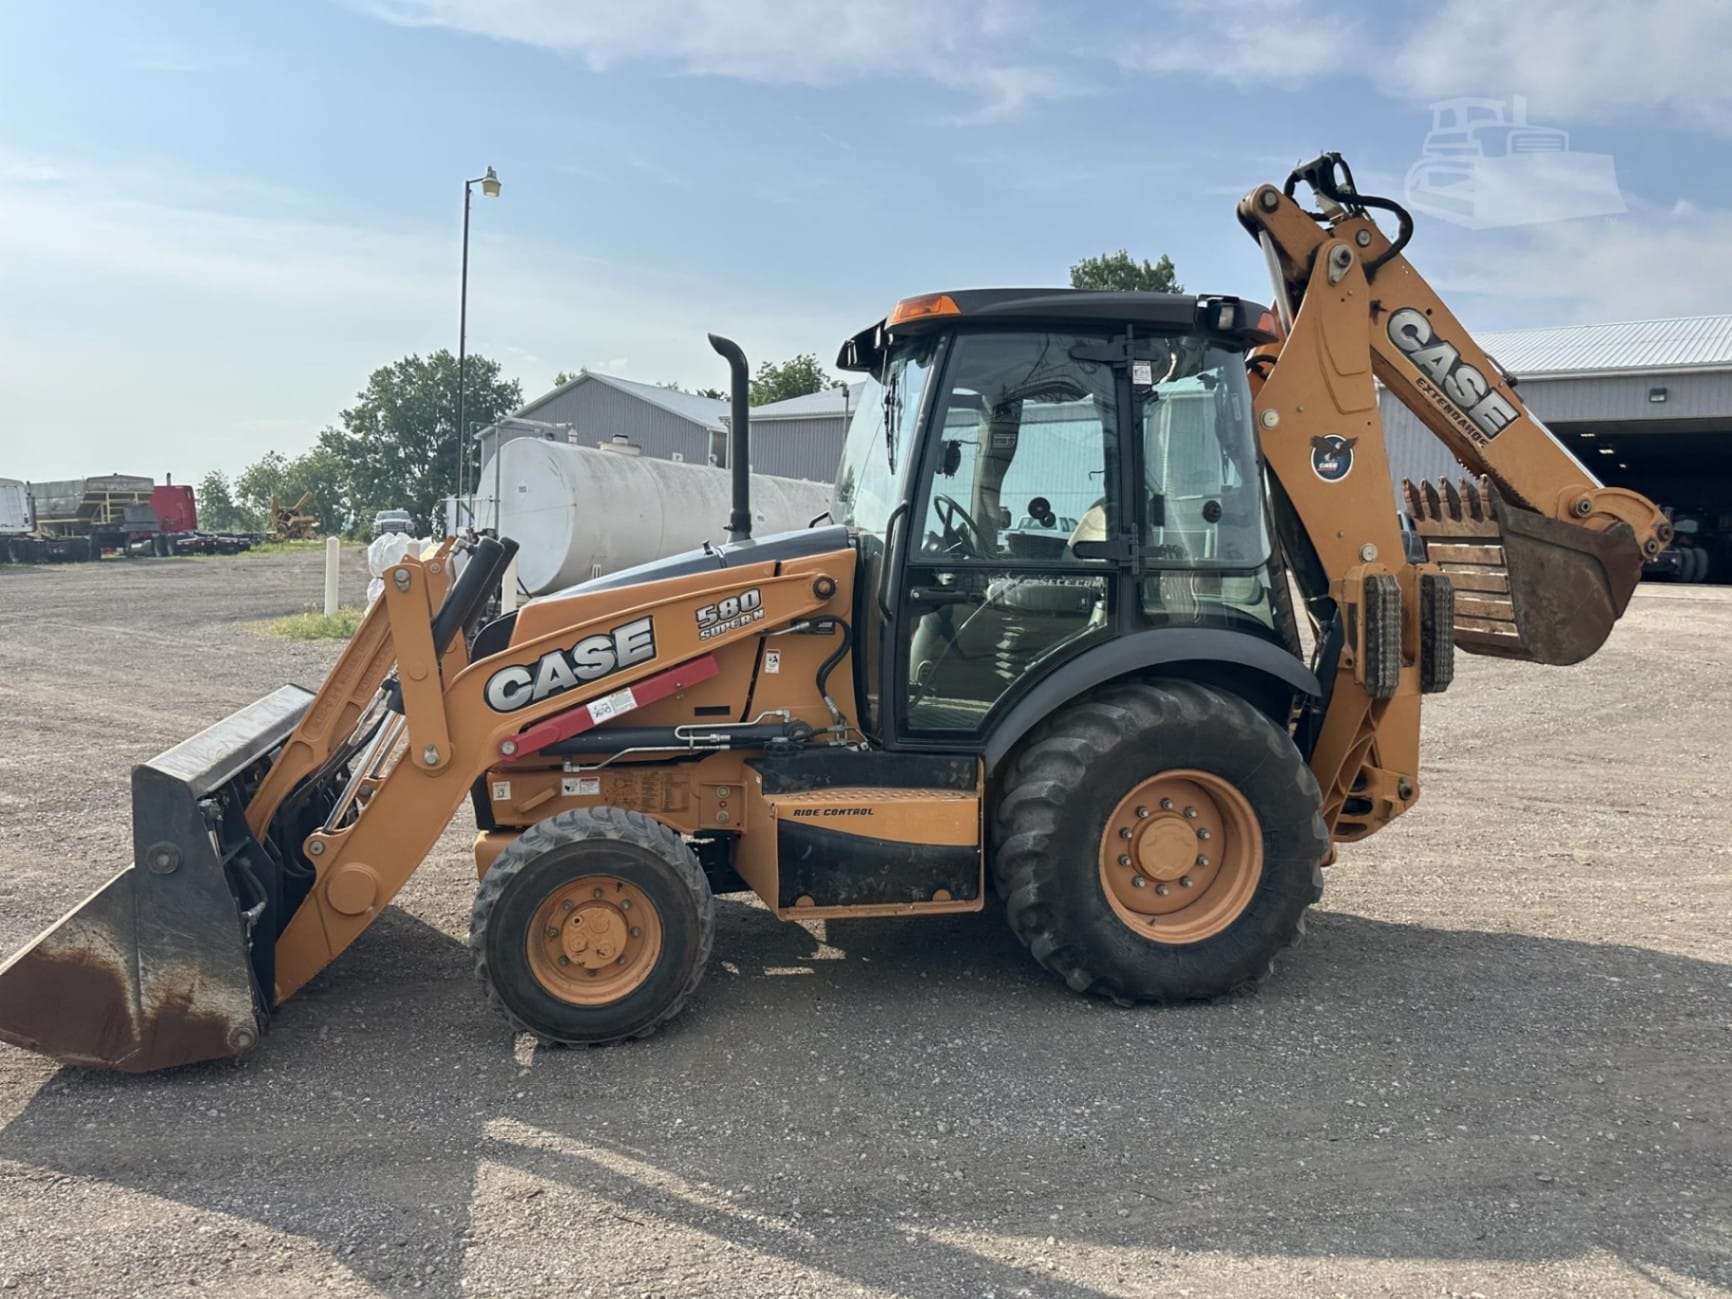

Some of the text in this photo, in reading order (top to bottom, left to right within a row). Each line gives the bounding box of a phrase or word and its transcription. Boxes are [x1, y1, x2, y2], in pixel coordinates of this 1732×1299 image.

[1388, 309, 1521, 438] CASE
[1416, 377, 1489, 448] EXTENDAHOE
[695, 588, 762, 629] 580
[699, 614, 752, 640] SUPER
[486, 616, 656, 713] CASE
[793, 807, 874, 817] RIDE CONTROL
